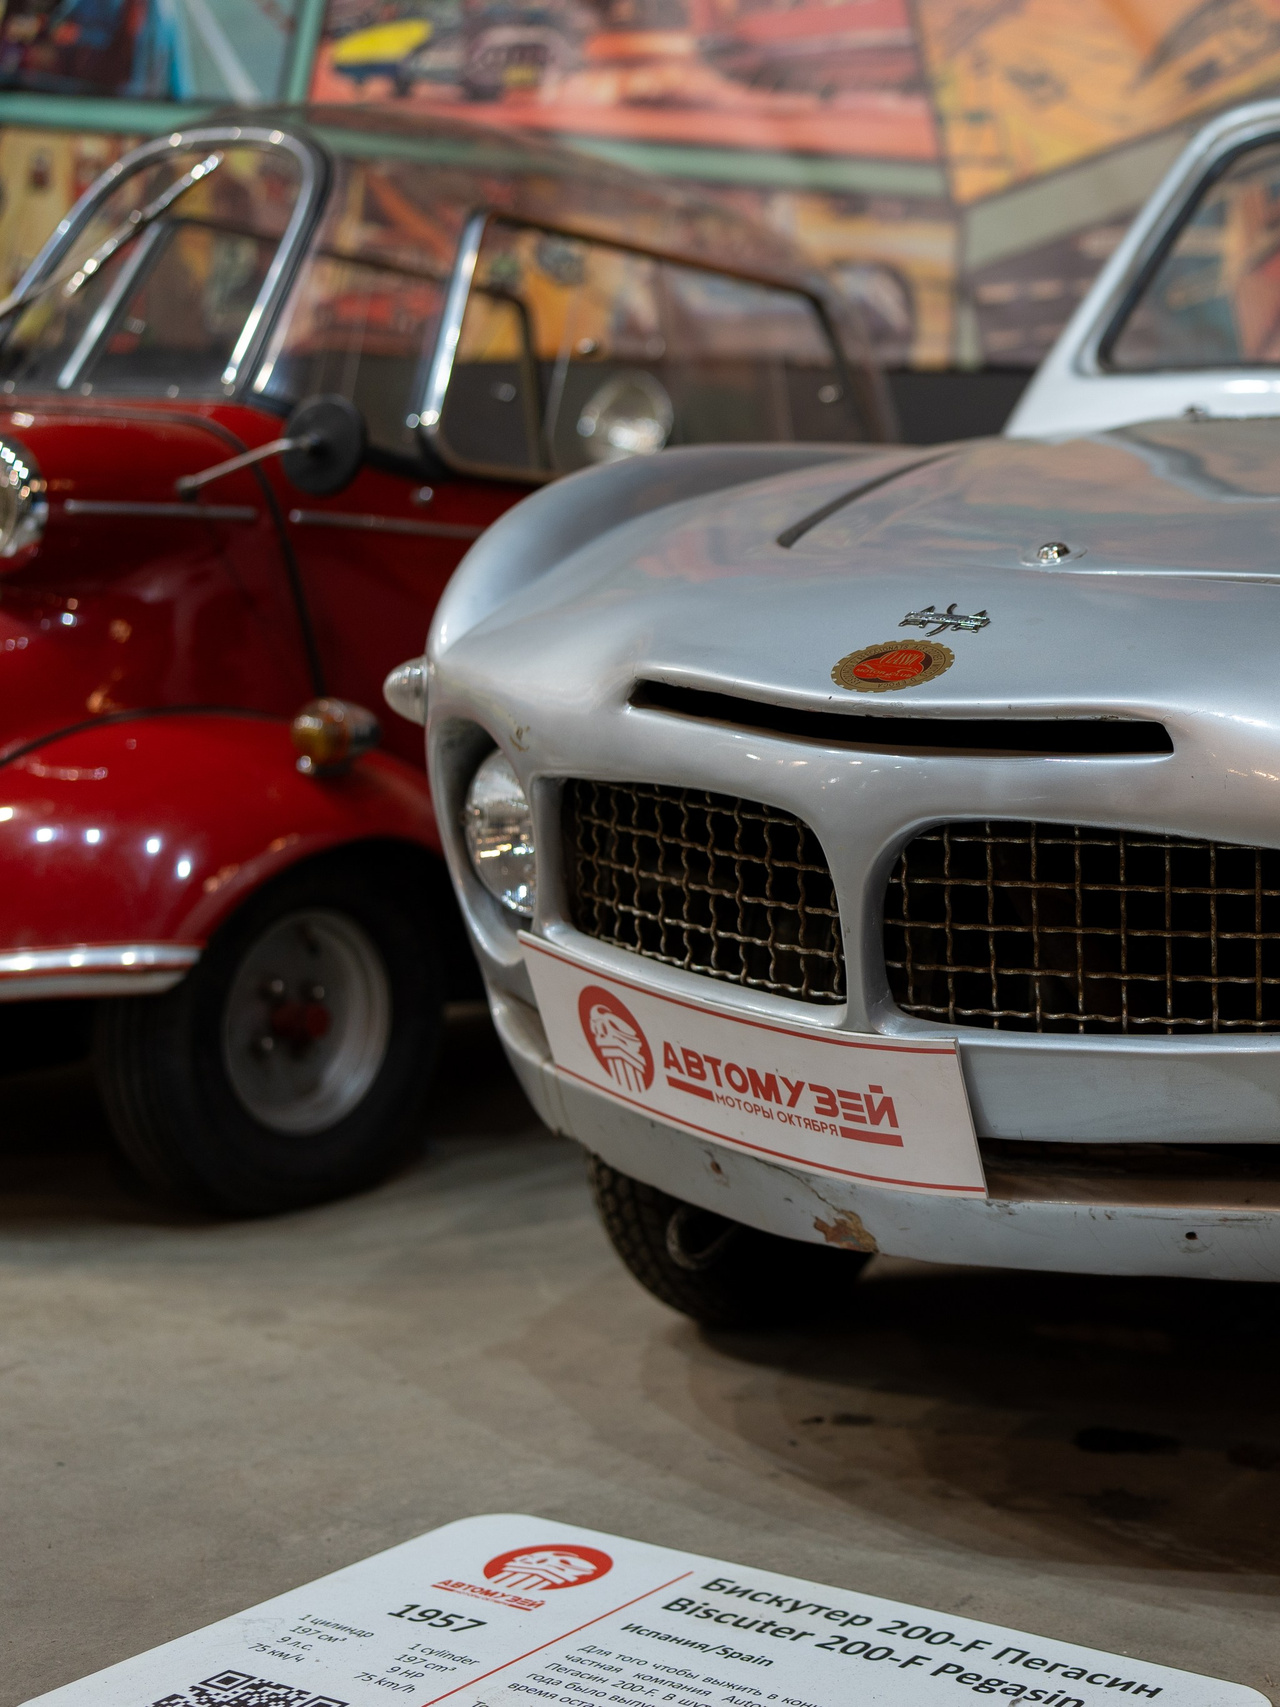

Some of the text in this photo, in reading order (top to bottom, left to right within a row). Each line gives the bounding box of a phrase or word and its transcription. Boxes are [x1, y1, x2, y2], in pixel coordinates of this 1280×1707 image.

[663, 1041, 899, 1128] АВТОМУЗЕЙ
[714, 1092, 839, 1137] МОТОРЫ ОКТЯБРЯ
[437, 1579, 546, 1609] АВТОМУЗЕЙ
[289, 1625, 321, 1636] 197
[310, 1618, 374, 1638] цилиндр
[387, 1604, 487, 1632] 1957
[287, 1641, 312, 1651] л.с.
[620, 1623, 774, 1667] Испания/Spain
[700, 1577, 1164, 1699] Бискутер 200-F Пегасин
[248, 1643, 305, 1662] 75 км/ч
[394, 1654, 427, 1665] 197
[420, 1647, 480, 1666] cylinder
[661, 1597, 1085, 1707] Biscuter 200-F Pegasin
[354, 1672, 415, 1694] 75 km/h
[398, 1669, 425, 1679] HP
[545, 1662, 609, 1684] Пегасин
[611, 1680, 659, 1697] 200-F.
[662, 1693, 677, 1701] В
[565, 1654, 623, 1673] частная
[633, 1672, 712, 1697] компания
[577, 1645, 612, 1657] Для
[616, 1653, 648, 1666] того
[652, 1663, 700, 1680] чтобы
[702, 1677, 762, 1697] выжить
[507, 1683, 558, 1700] время
[526, 1673, 563, 1686] года
[564, 1682, 607, 1698] было
